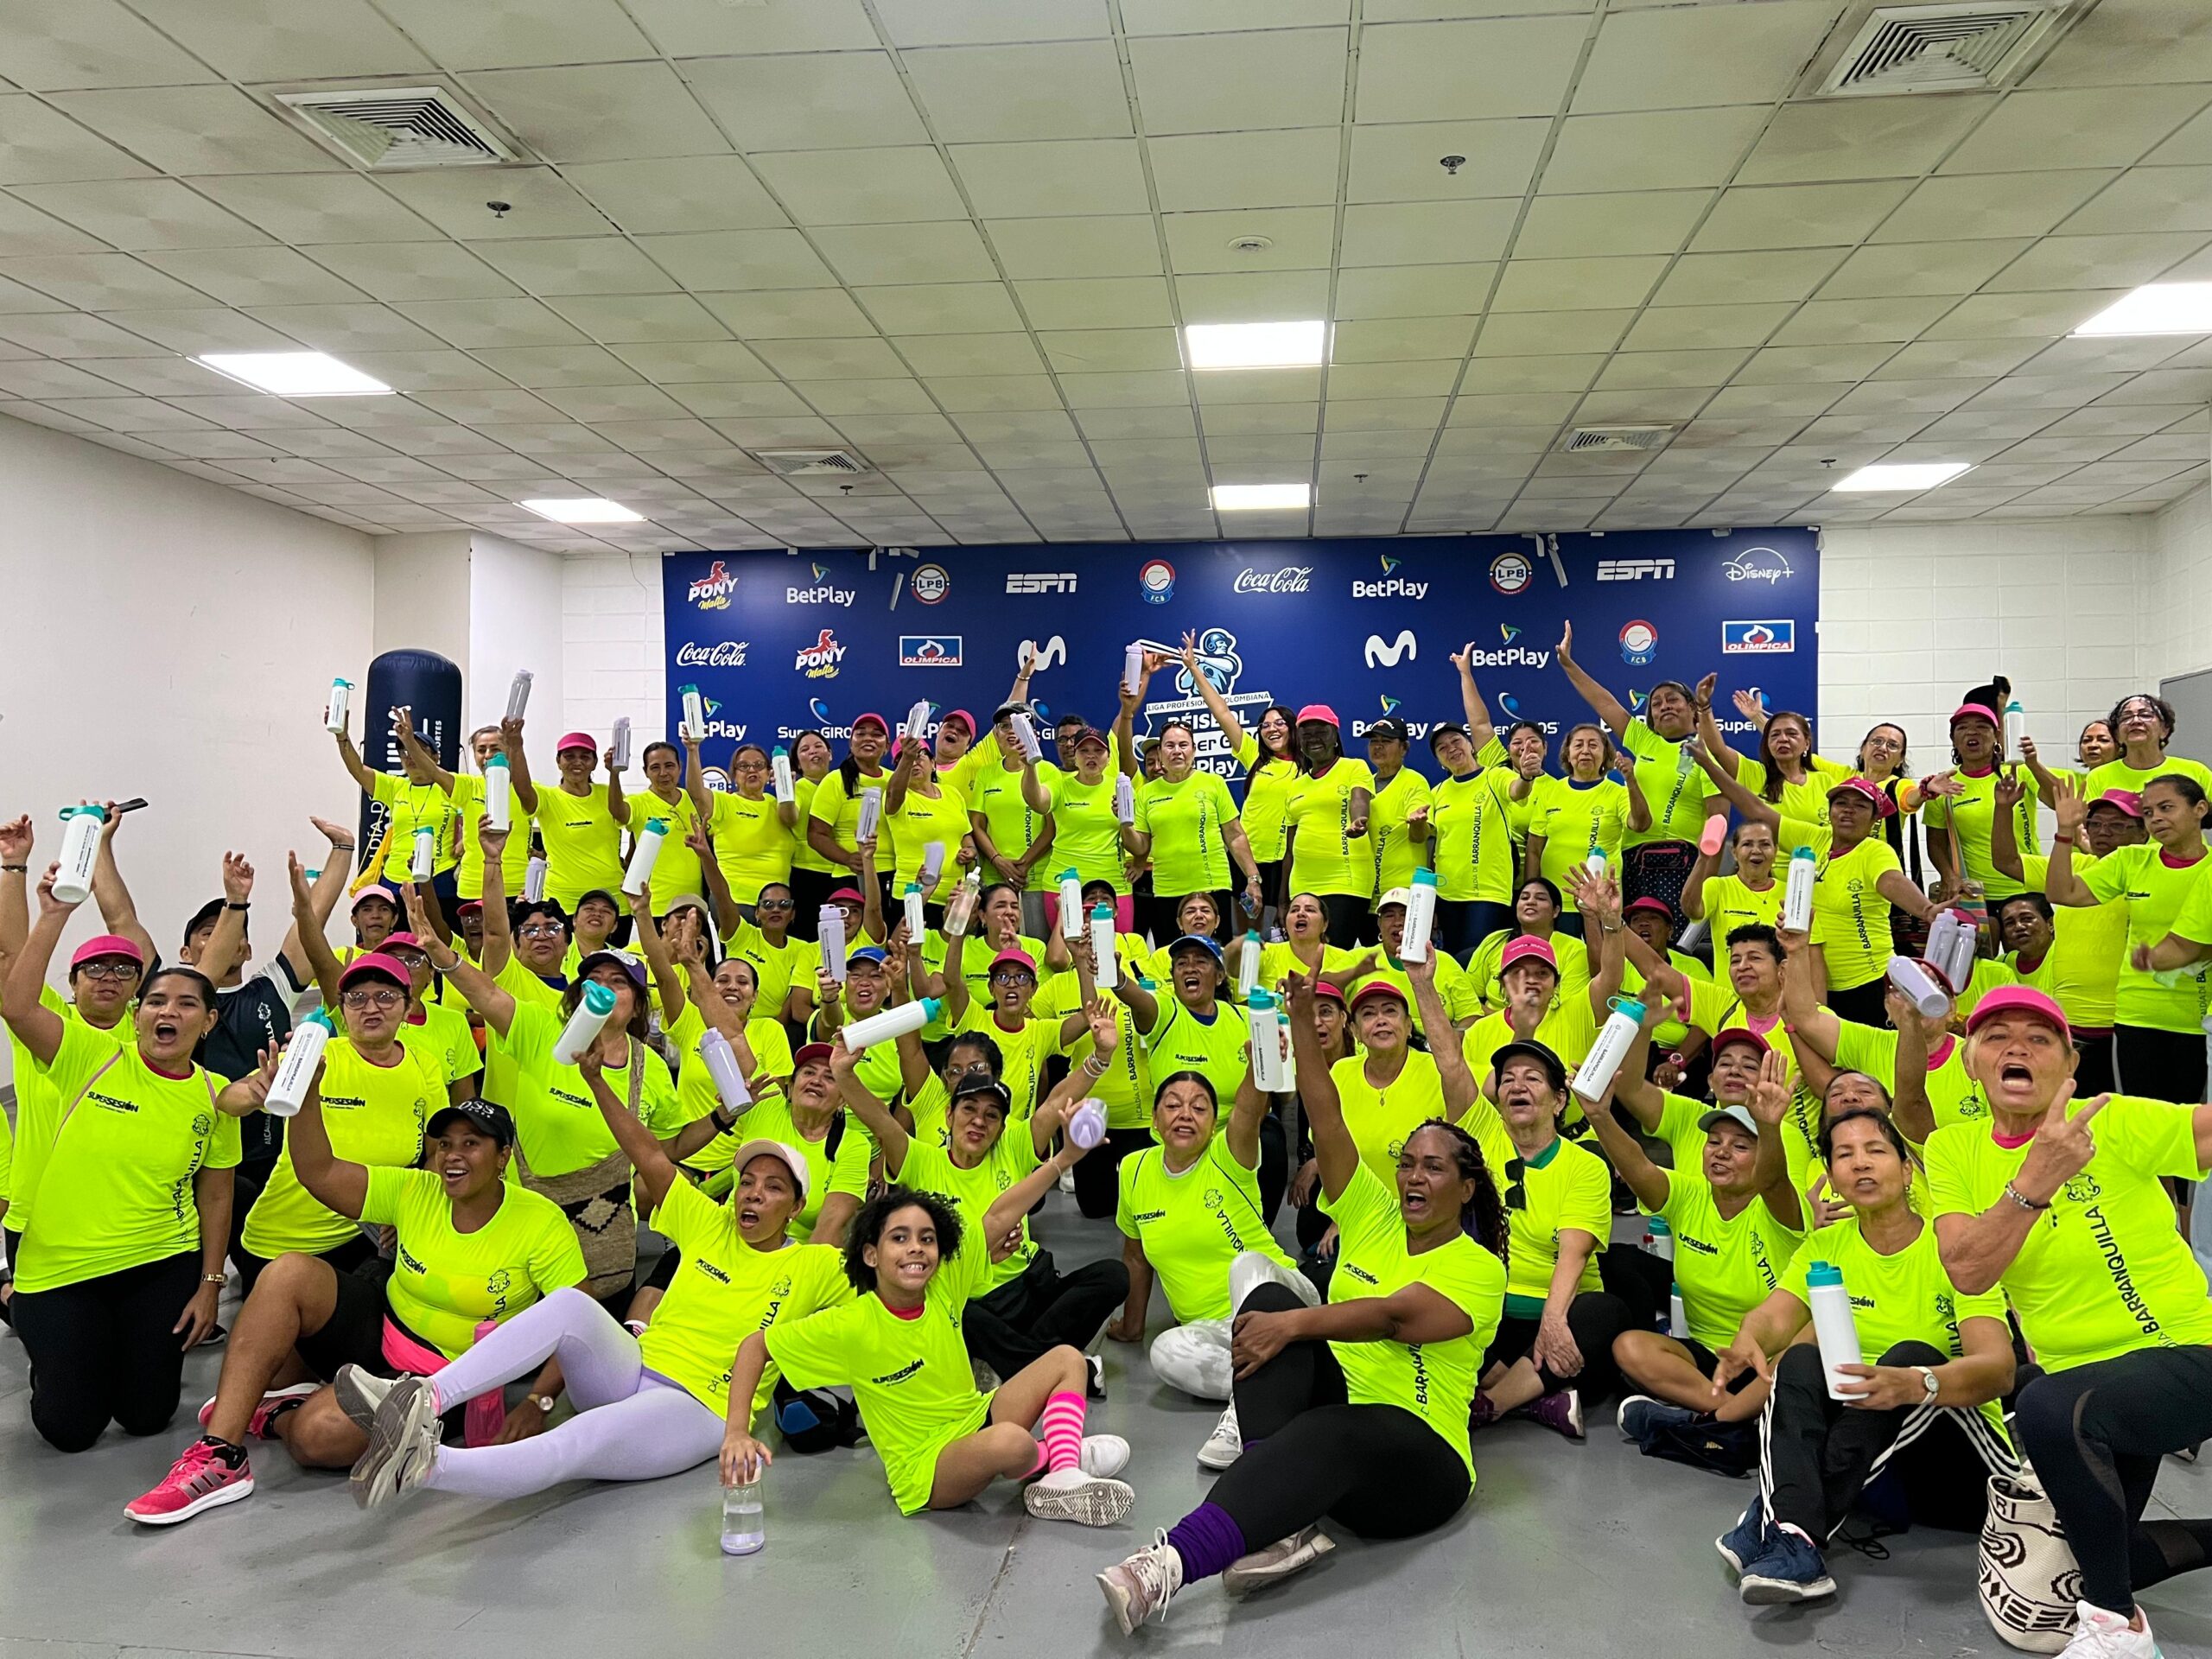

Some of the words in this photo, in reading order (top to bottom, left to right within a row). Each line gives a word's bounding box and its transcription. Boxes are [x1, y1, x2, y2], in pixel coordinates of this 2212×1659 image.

[1234, 567, 1313, 594] Coca-Cola
[1497, 569, 1525, 579] LPB
[1597, 559, 1675, 581] ESPN
[688, 577, 739, 601] PONY
[918, 579, 943, 588] LPB
[1006, 572, 1077, 594] ESPN
[1352, 578, 1428, 600] BetPlay
[698, 595, 728, 610] Malta
[786, 586, 855, 607] BetPlay
[677, 641, 749, 666] Coca-Cola
[1472, 646, 1549, 669] BetPlay
[1727, 642, 1790, 652] OLIMPICA
[795, 646, 847, 670] PONY
[904, 656, 959, 665] OLIMPICA
[805, 664, 836, 679] Malta
[1147, 702, 1165, 711] LIGA
[1224, 693, 1269, 703] OLOMBIANA
[677, 721, 747, 741] BtPlay
[1192, 757, 1238, 778] Play
[709, 782, 725, 791] PB
[1663, 772, 1687, 824] BARRANQUILL
[1471, 805, 1482, 865] BARRANQUILLA
[1123, 1011, 1138, 1081] BARRANQUILLA
[321, 1096, 365, 1107] UPERSESIÓN
[2085, 1205, 2160, 1334] BARRANQUILLA
